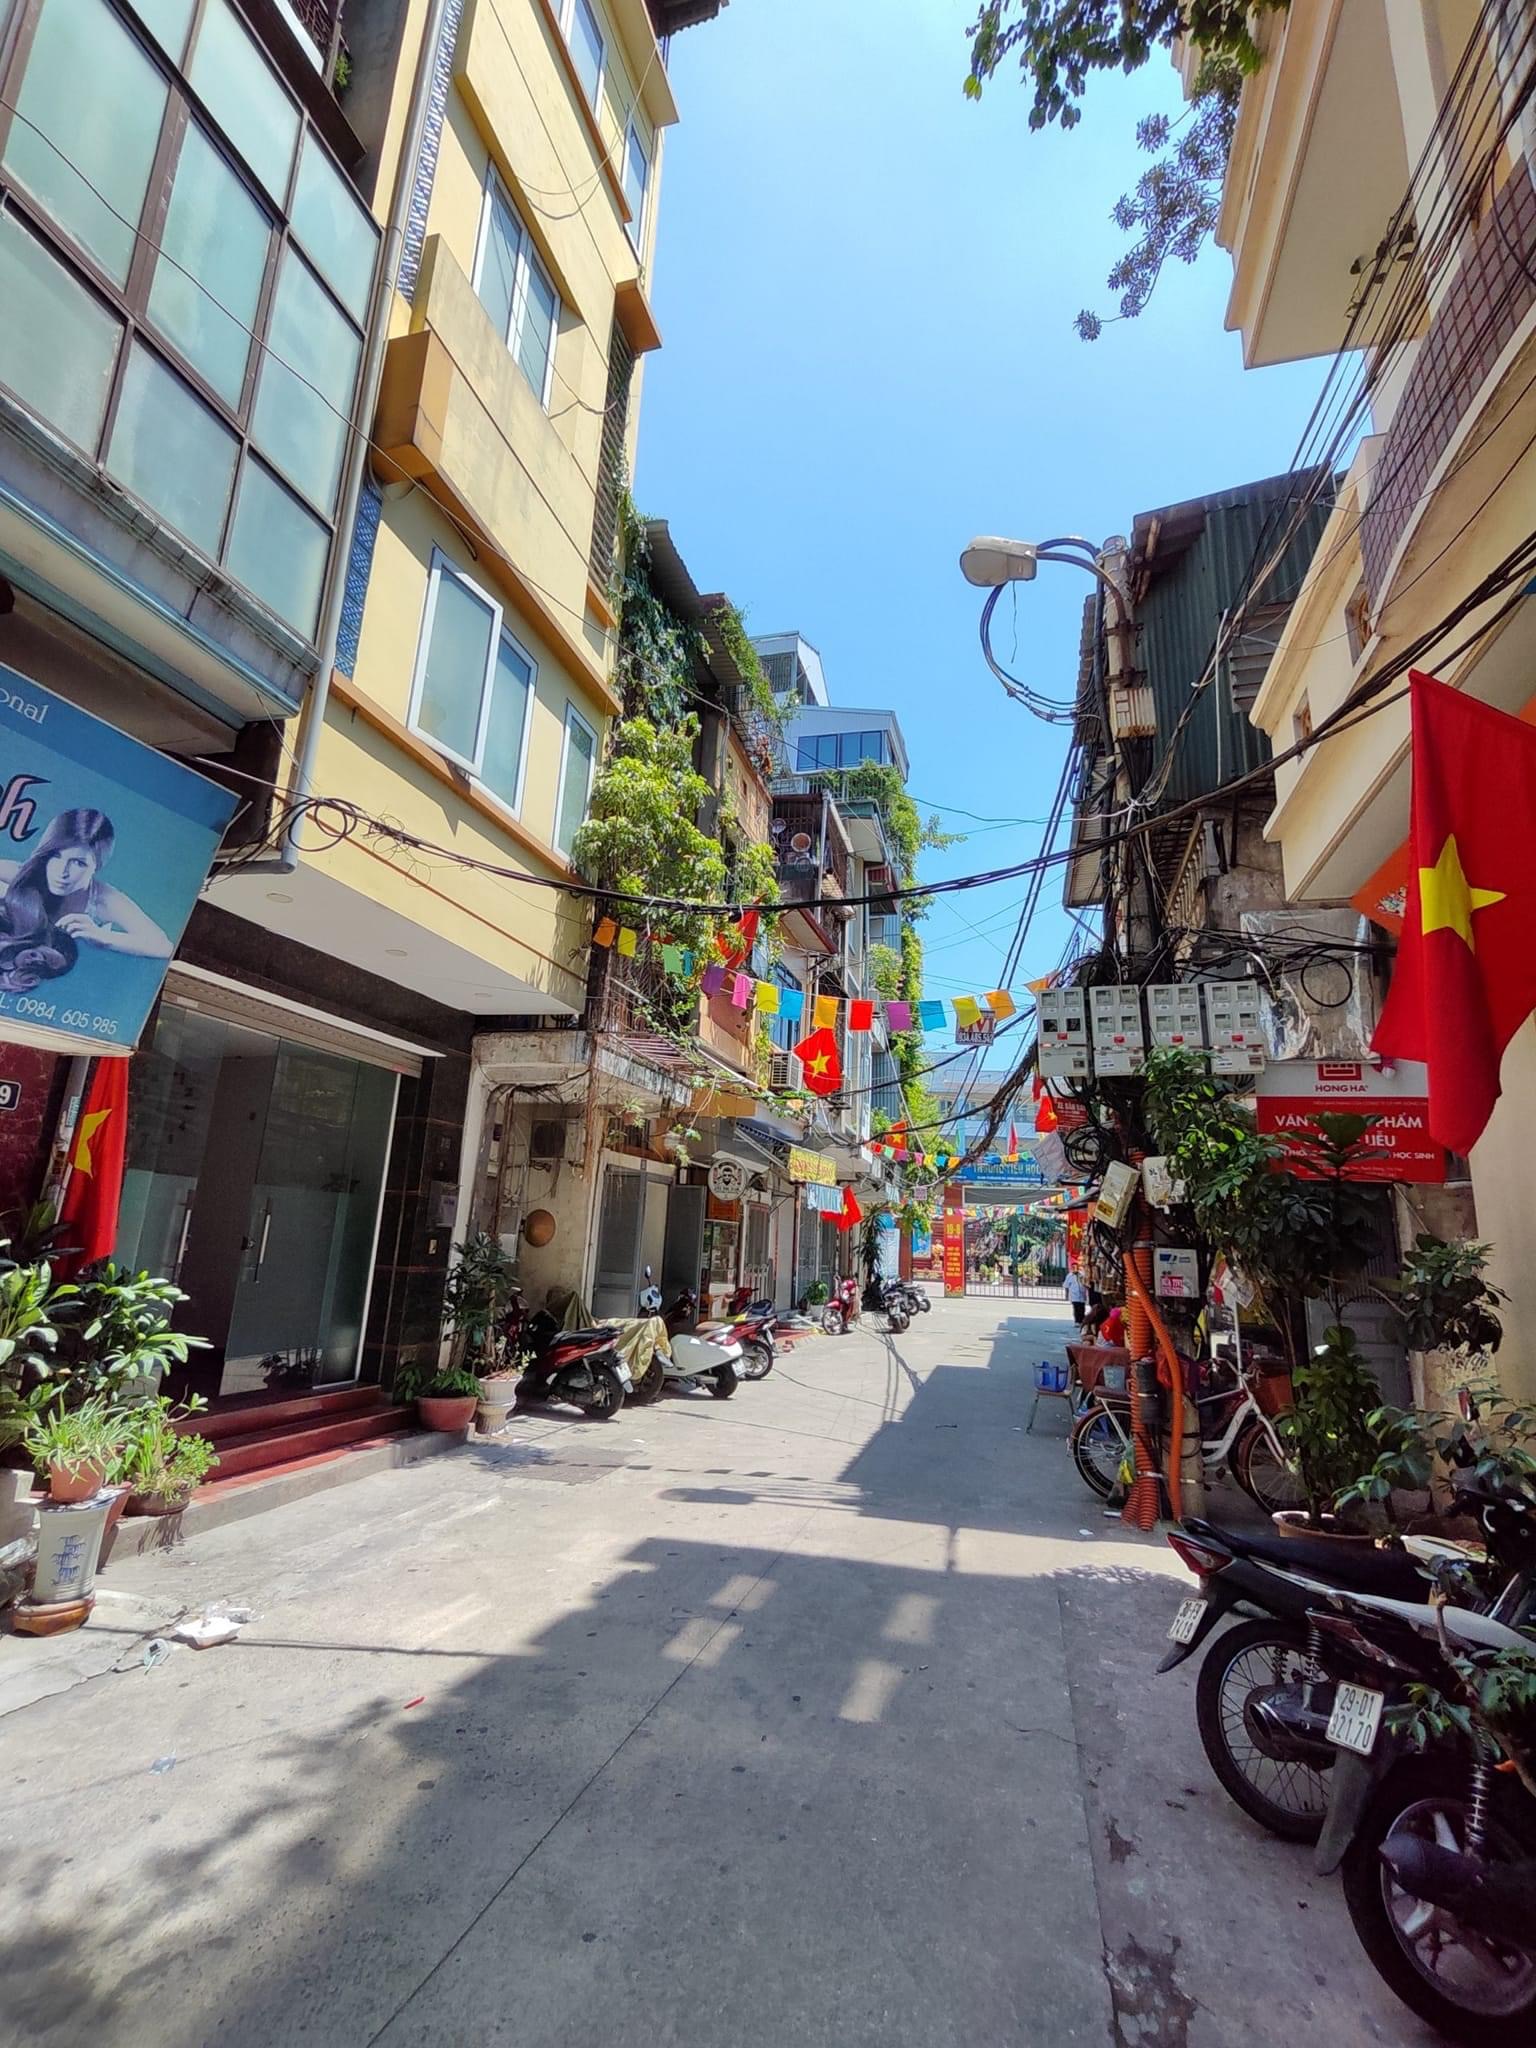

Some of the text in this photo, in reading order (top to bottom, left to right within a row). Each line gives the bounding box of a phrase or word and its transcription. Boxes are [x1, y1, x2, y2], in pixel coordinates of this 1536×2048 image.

[15, 997, 57, 1021] 0984.
[61, 1009, 90, 1028] 605
[92, 1016, 118, 1035] 985
